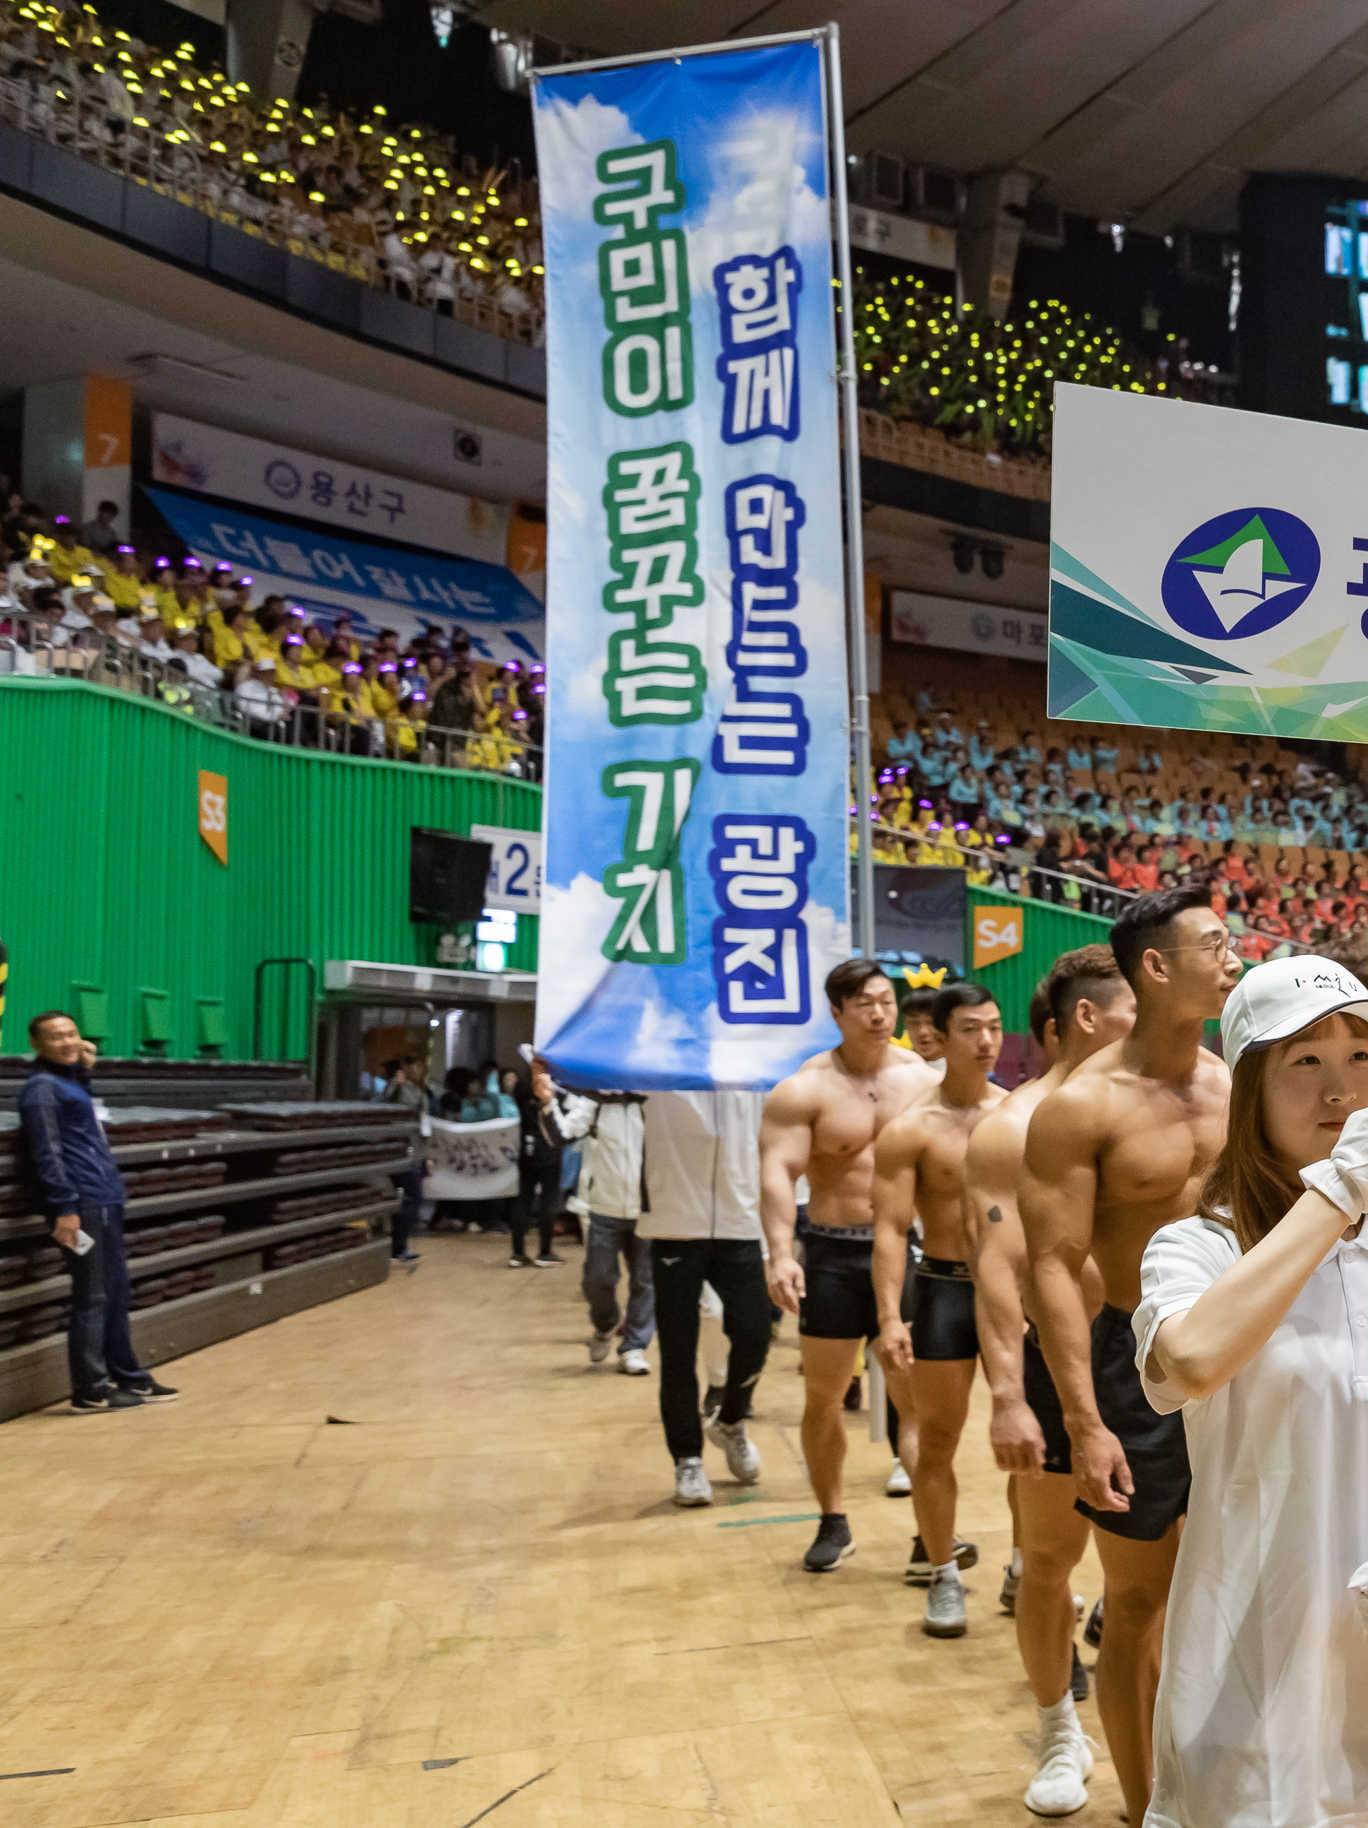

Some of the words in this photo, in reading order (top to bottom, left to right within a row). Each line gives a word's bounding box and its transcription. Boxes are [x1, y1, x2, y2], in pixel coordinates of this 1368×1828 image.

[595, 138, 695, 418] 구민이
[714, 246, 803, 445] 함께
[99, 433, 119, 465] 7
[310, 470, 407, 524] 용산구
[603, 442, 707, 728] 꿈꾸는
[712, 474, 811, 776] 만드는
[201, 790, 226, 832] S3
[708, 814, 816, 1025] 광진
[978, 918, 1020, 949] S4
